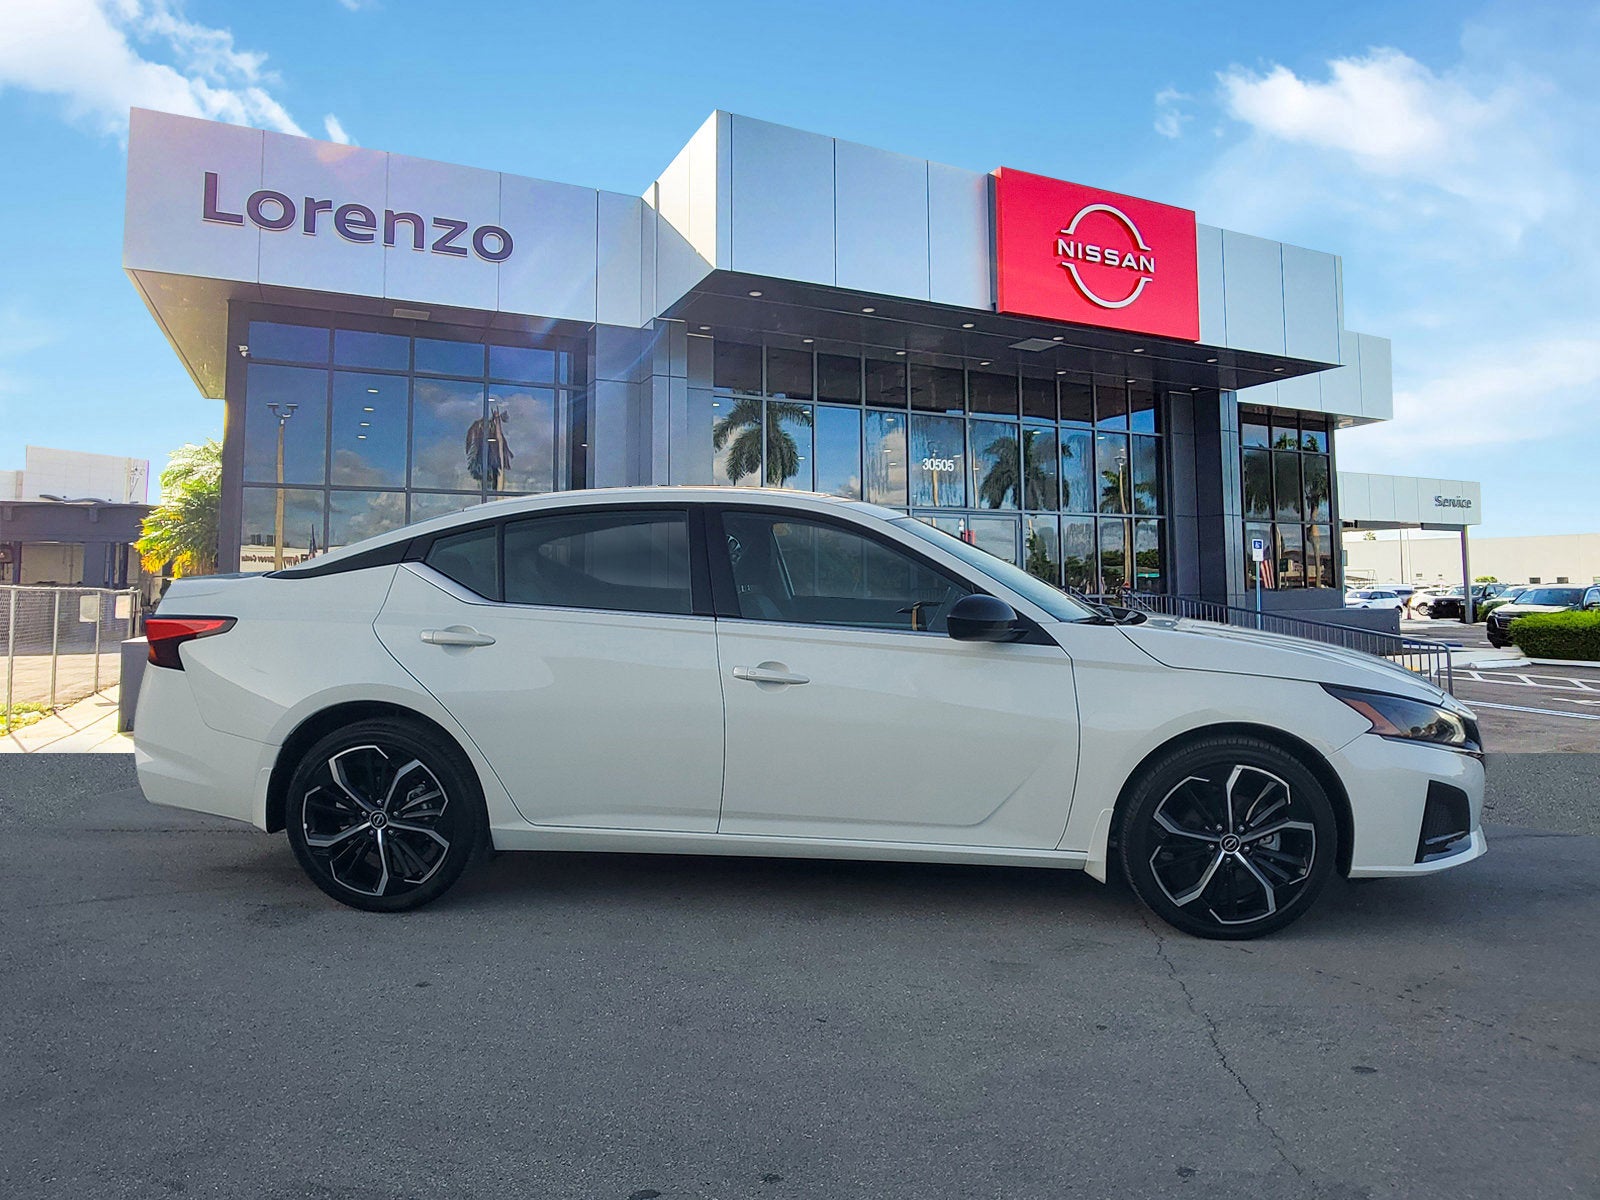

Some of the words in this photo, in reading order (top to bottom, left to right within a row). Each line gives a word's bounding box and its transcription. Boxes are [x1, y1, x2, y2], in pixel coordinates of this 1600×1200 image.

[202, 171, 514, 262] Lorenzo
[1057, 238, 1155, 273] NISSAN
[922, 458, 955, 471] 30505
[1434, 495, 1472, 508] Service
